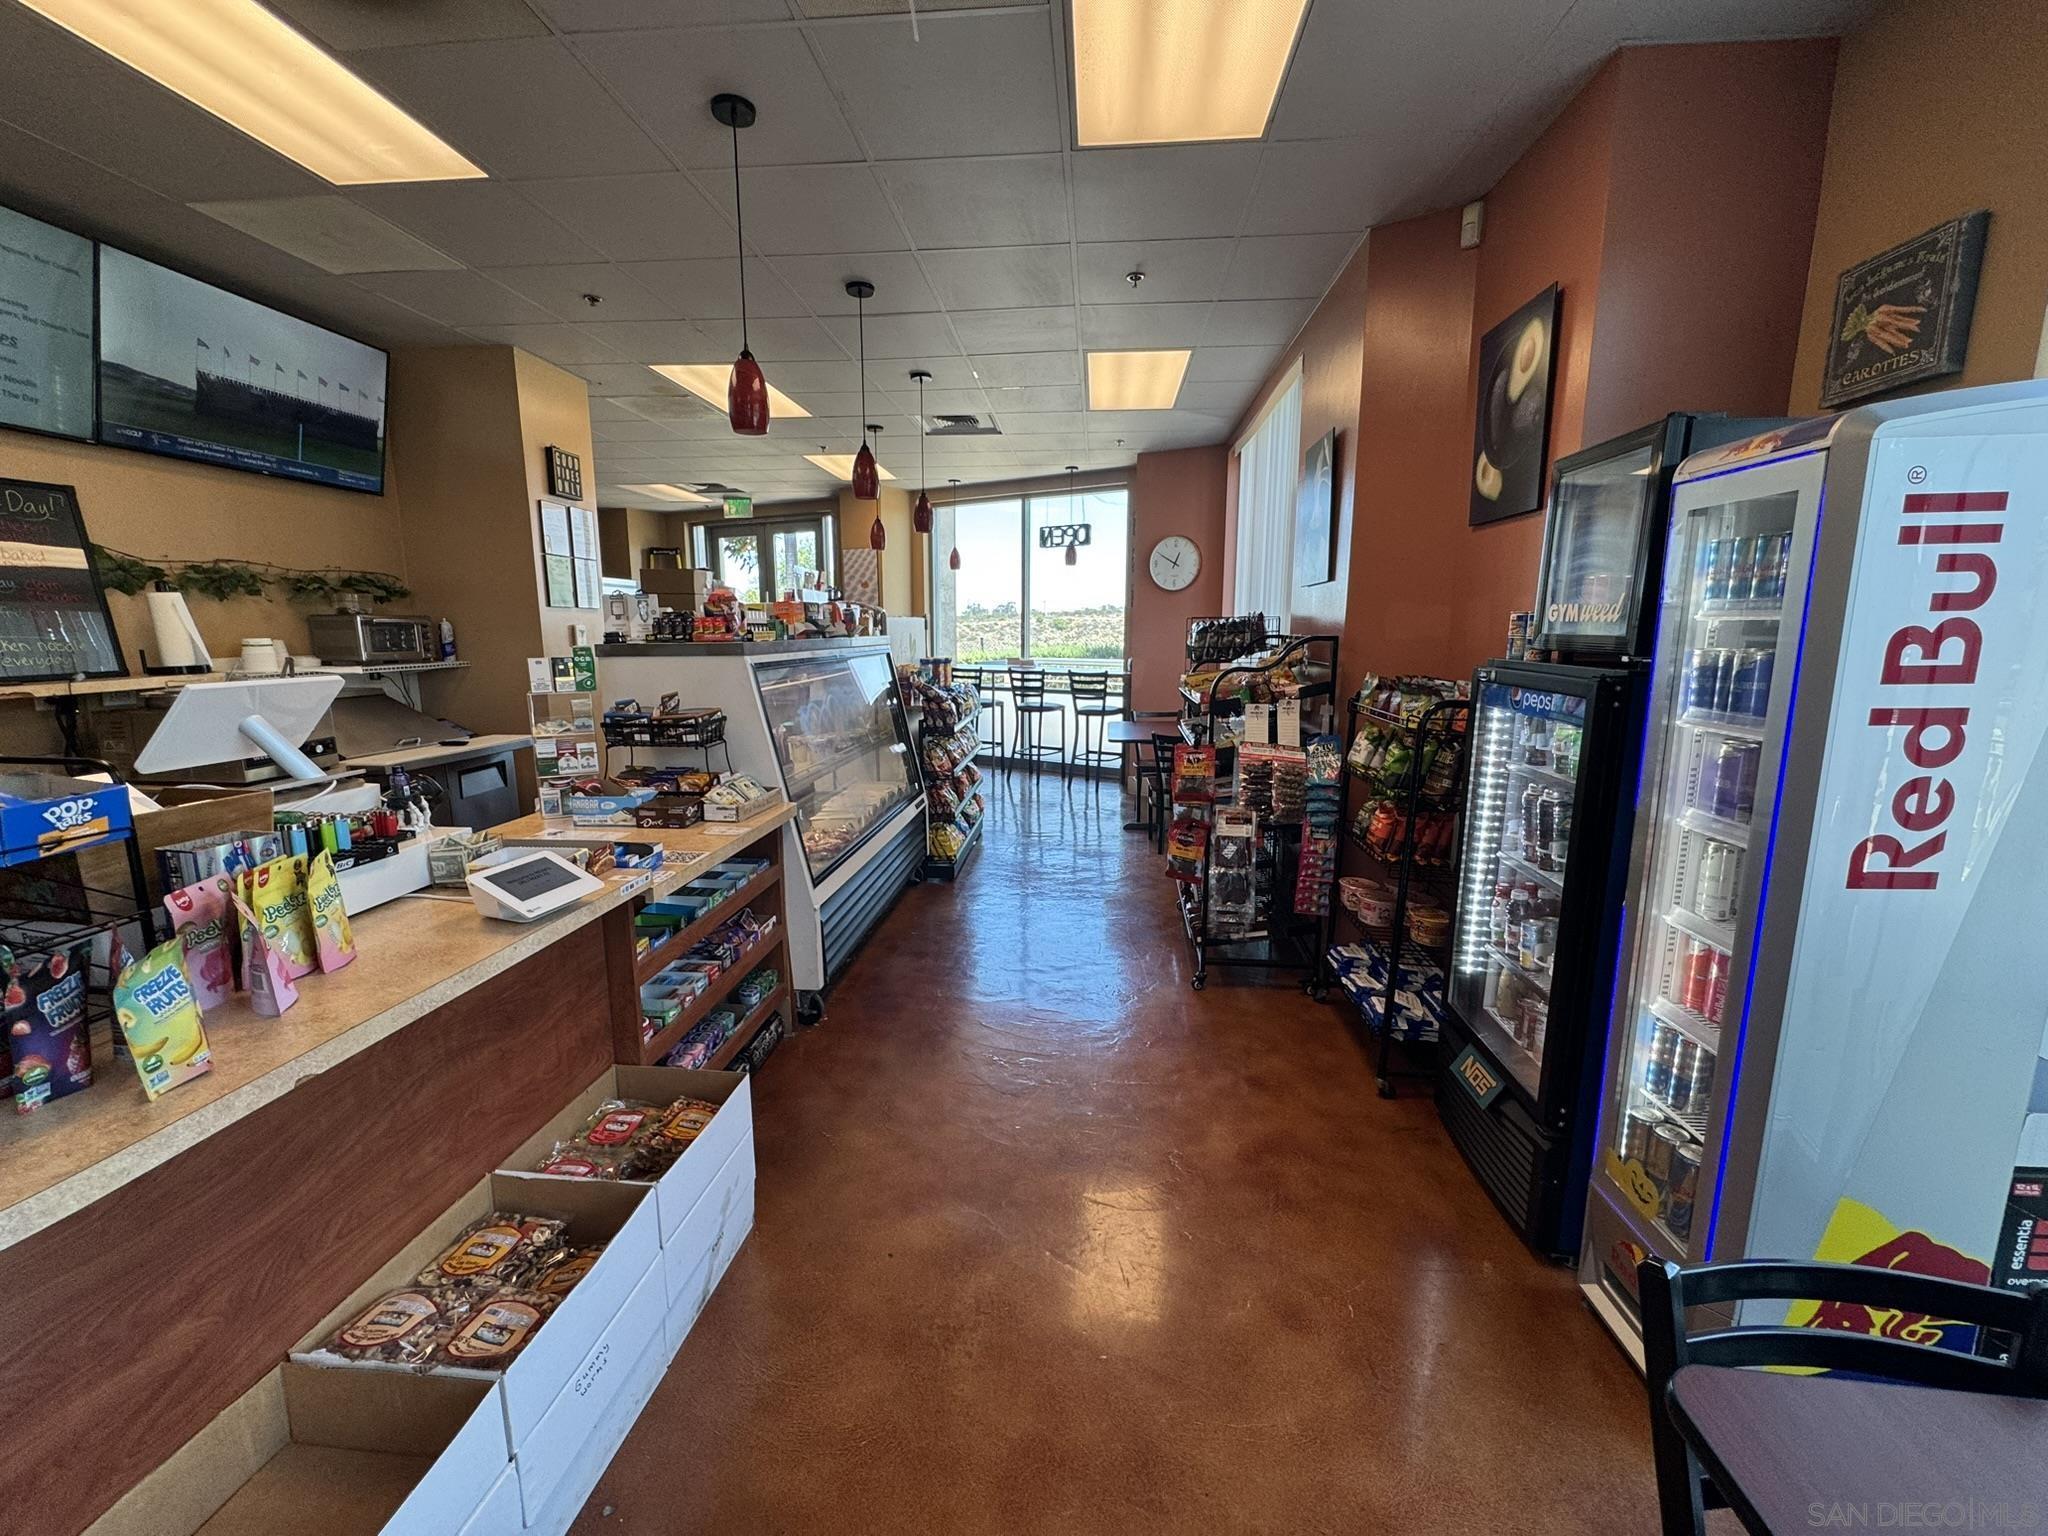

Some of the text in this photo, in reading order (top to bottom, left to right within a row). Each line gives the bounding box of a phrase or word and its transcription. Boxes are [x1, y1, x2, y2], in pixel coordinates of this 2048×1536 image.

[1842, 350, 1920, 386] CAROTTES
[555, 451, 579, 471] GOOD
[1548, 592, 1626, 623] GYM weed
[1522, 692, 1555, 712] pepsi
[1846, 491, 2010, 889] Red Bull
[55, 812, 92, 831] tarts
[134, 964, 182, 1002] FREEZIE
[146, 979, 190, 1016] FRUITS
[1460, 1055, 1497, 1096] NOS
[2011, 1219, 2034, 1270] essentia
[575, 1343, 610, 1392] Gummy
